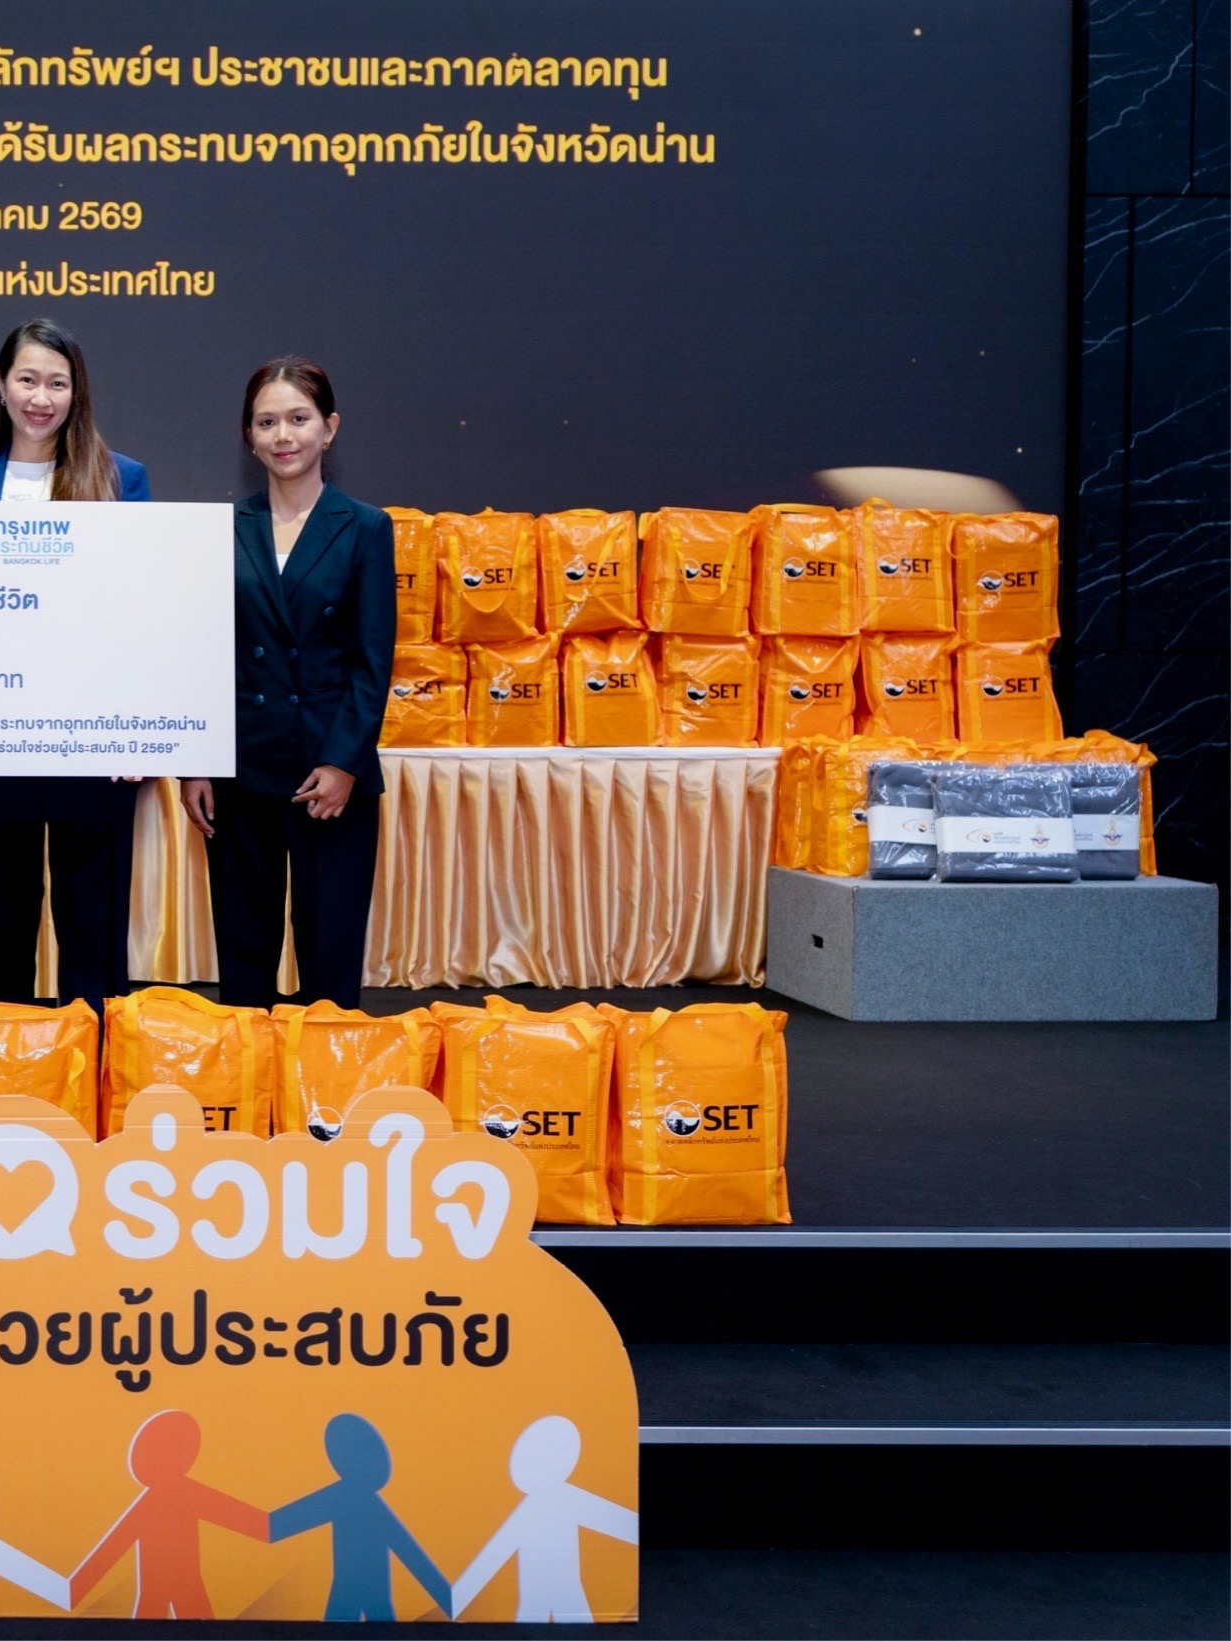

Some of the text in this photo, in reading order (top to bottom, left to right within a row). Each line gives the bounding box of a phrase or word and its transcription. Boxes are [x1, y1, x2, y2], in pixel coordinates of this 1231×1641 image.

[192, 47, 668, 100] ประชาชนและภาคตลาดทุน
[58, 200, 143, 231] 2569
[2, 557, 61, 565] BANGKOK LIFE
[901, 558, 933, 573] SET
[806, 561, 838, 577] SET
[395, 574, 418, 589] ET
[1004, 571, 1039, 587] SET
[414, 681, 445, 694] SET
[608, 673, 638, 688] SET
[906, 679, 937, 694] SET
[1005, 677, 1040, 693] SET
[511, 683, 542, 698] SET
[709, 684, 741, 698] SET
[812, 683, 843, 698] SET
[128, 739, 138, 754] ปี
[202, 1107, 237, 1131] ET
[522, 1110, 581, 1136] SET
[703, 1104, 759, 1131] SET
[103, 1112, 511, 1260] ร่วมใจ
